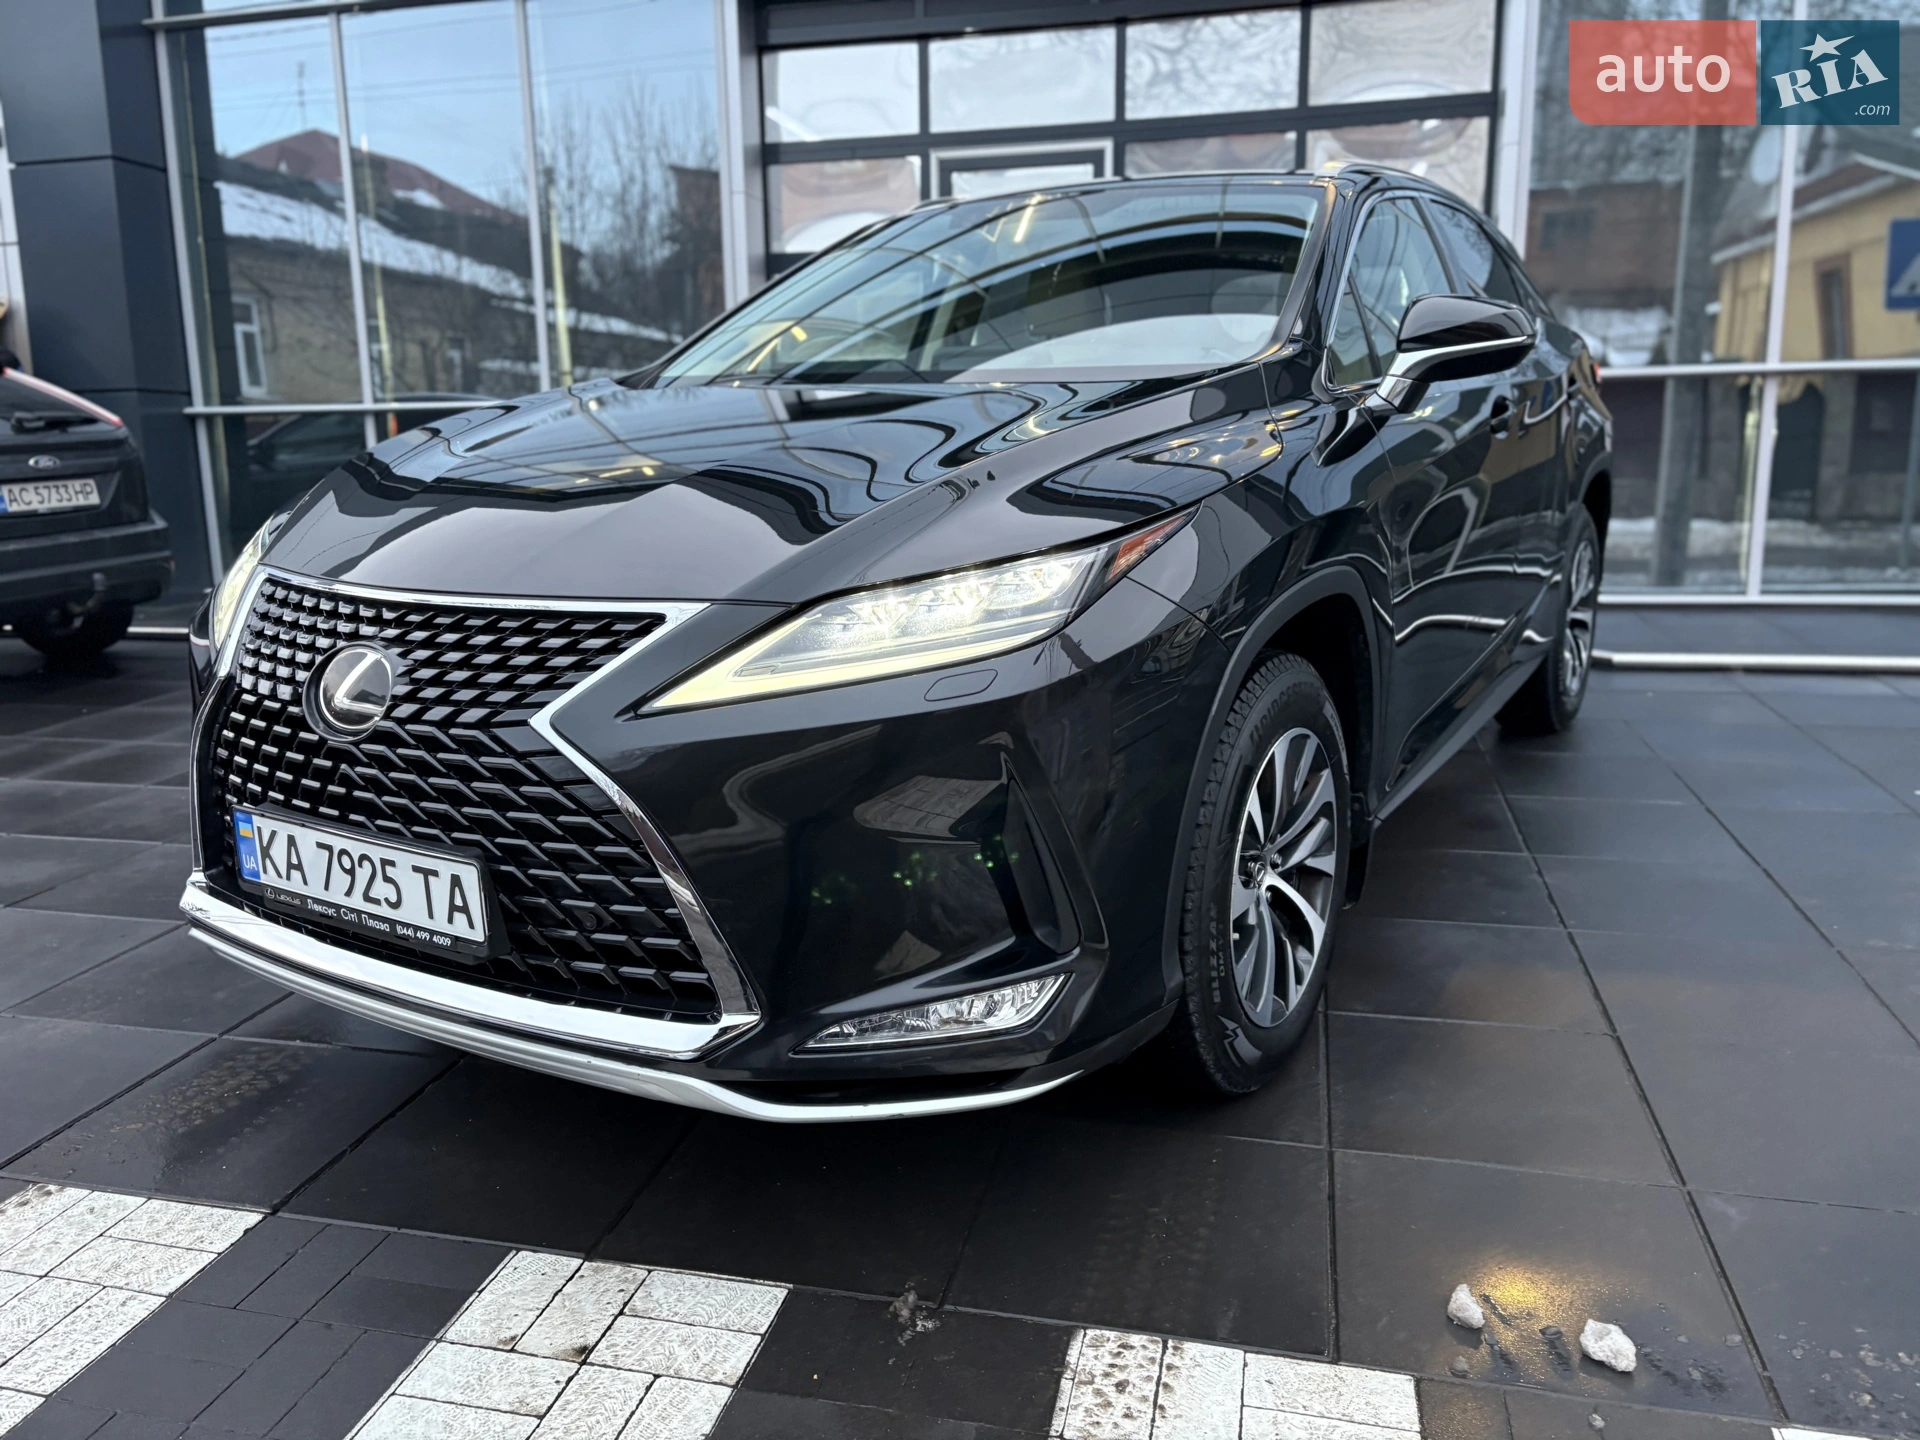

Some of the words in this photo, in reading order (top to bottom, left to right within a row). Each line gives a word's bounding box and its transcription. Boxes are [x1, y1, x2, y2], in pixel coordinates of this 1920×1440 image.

[7, 487, 32, 508] AC
[33, 484, 73, 505] 5733
[72, 482, 94, 503] HP
[243, 853, 258, 871] UA
[256, 825, 309, 886] KA
[315, 840, 403, 910] 7925
[411, 864, 476, 930] TA
[307, 898, 338, 918] Лексус
[361, 914, 391, 933] Плаза
[395, 922, 415, 939] (044)
[415, 929, 430, 942] 499
[432, 933, 452, 947] 4009
